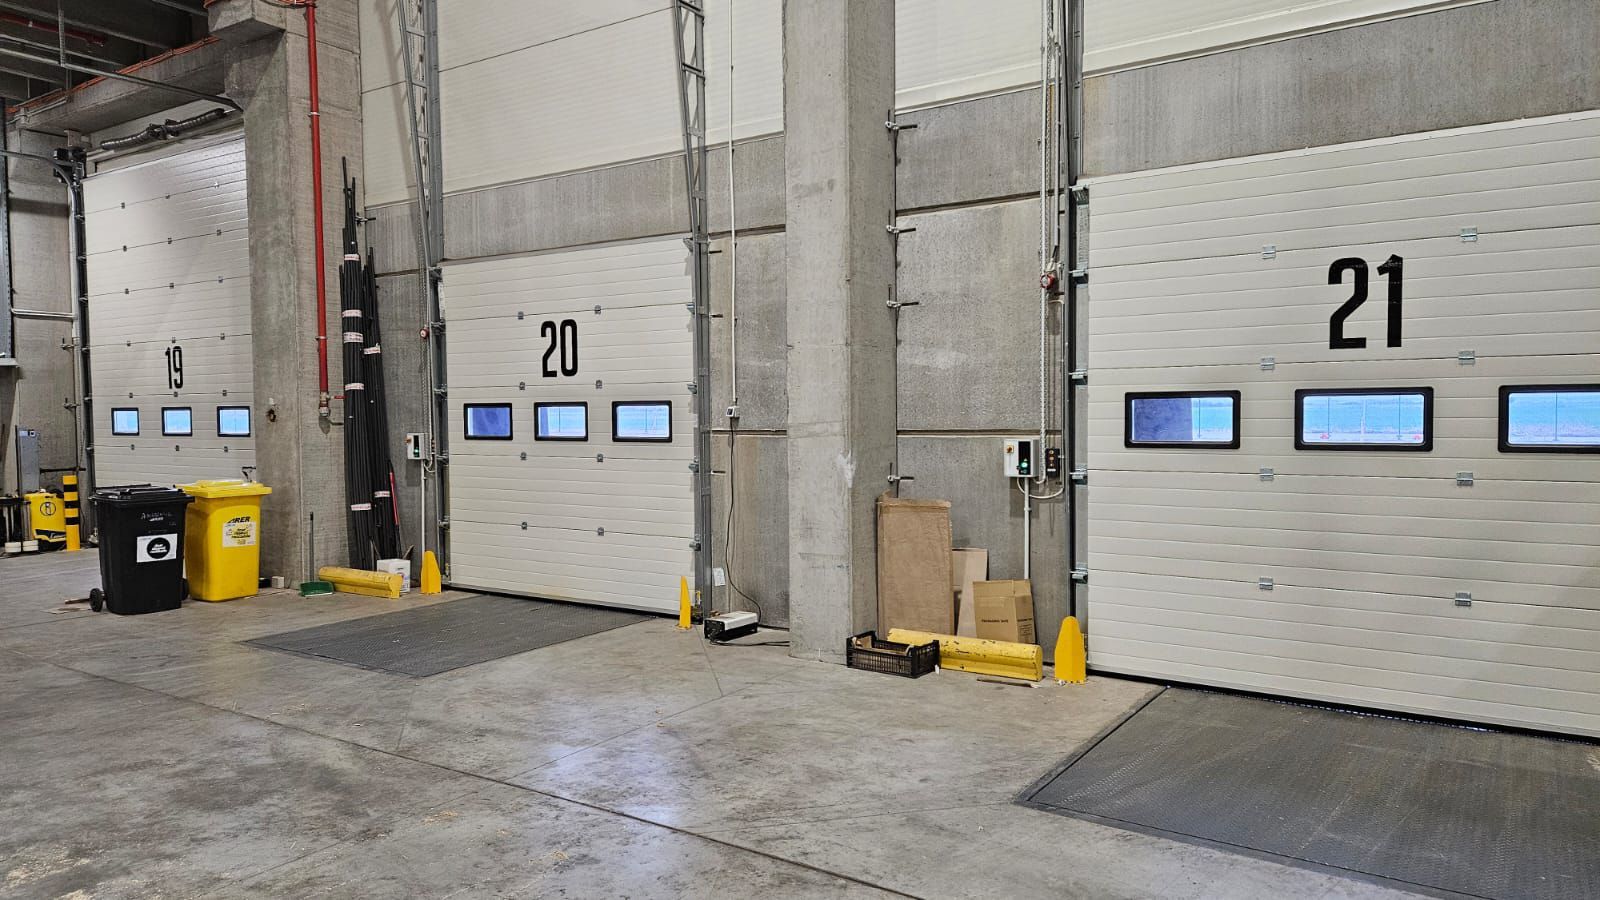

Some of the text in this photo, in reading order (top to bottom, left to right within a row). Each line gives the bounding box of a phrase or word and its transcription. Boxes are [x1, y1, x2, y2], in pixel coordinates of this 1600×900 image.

[1328, 254, 1403, 349] 21
[165, 346, 183, 389] 19
[541, 319, 578, 377] 20
